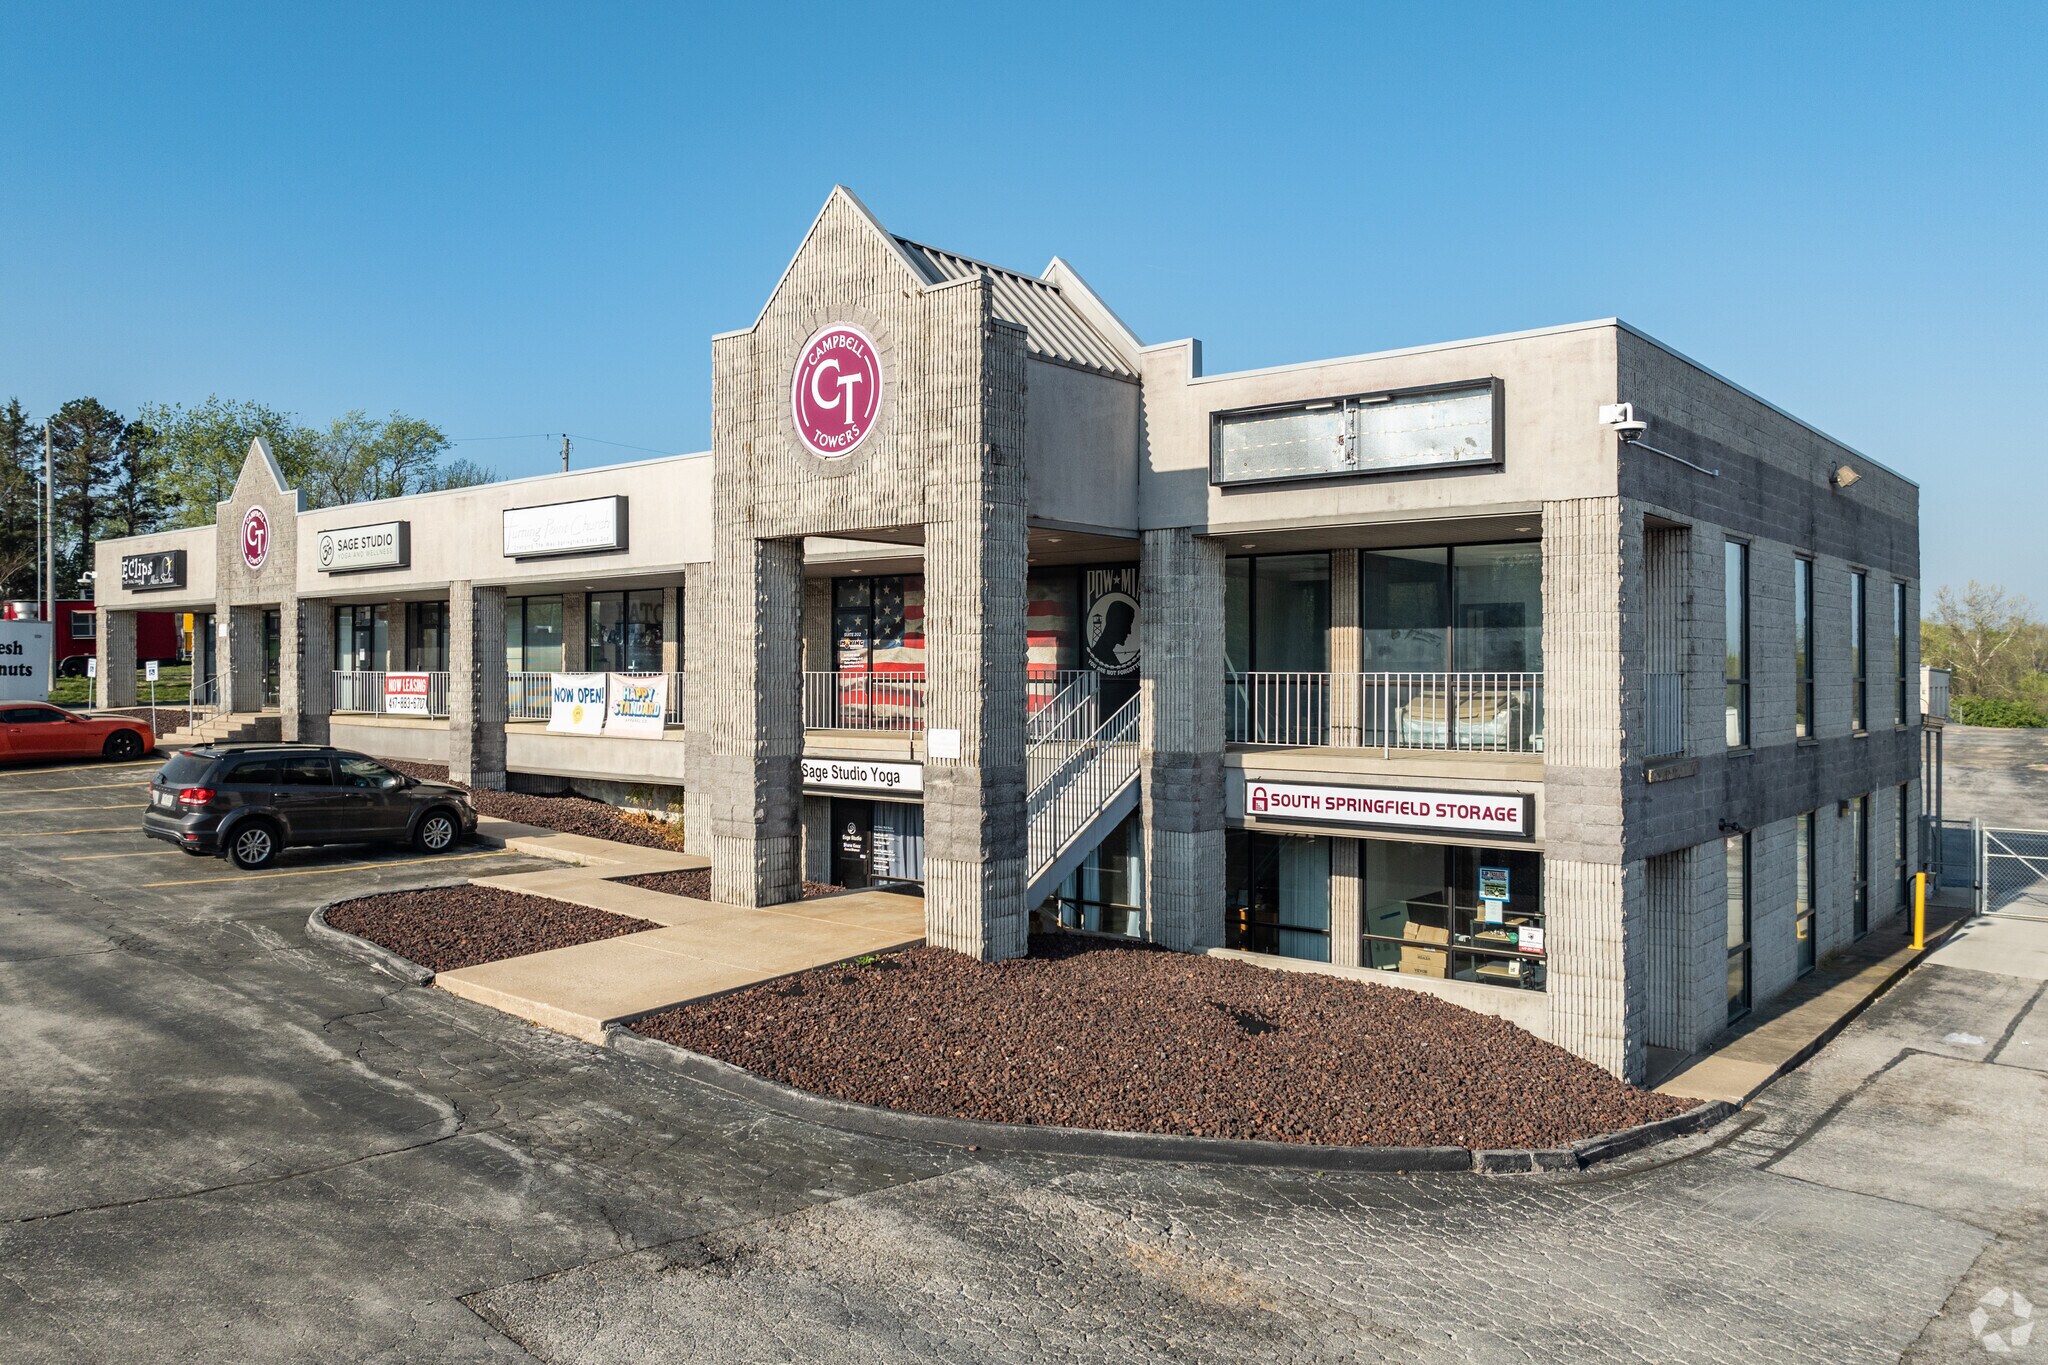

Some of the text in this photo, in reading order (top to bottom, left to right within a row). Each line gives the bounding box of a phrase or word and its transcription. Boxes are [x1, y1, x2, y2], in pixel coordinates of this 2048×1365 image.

[808, 334, 864, 366] CAMPBELL
[811, 358, 863, 425] CT
[813, 423, 860, 448] TOWERS
[247, 521, 264, 554] CT
[338, 533, 393, 551] SAGE STUDIO
[366, 548, 393, 557] WELLNESS
[1087, 569, 1113, 613] POW
[389, 679, 425, 692] NOW LEASING
[554, 687, 604, 704] NOW OPEN!
[623, 687, 655, 702] HAPPY
[614, 700, 661, 718] STANDARD
[802, 763, 900, 787] Sage Studio Yoga
[1271, 793, 1517, 822] SOUTH SPRINGFIELD STORAGE
